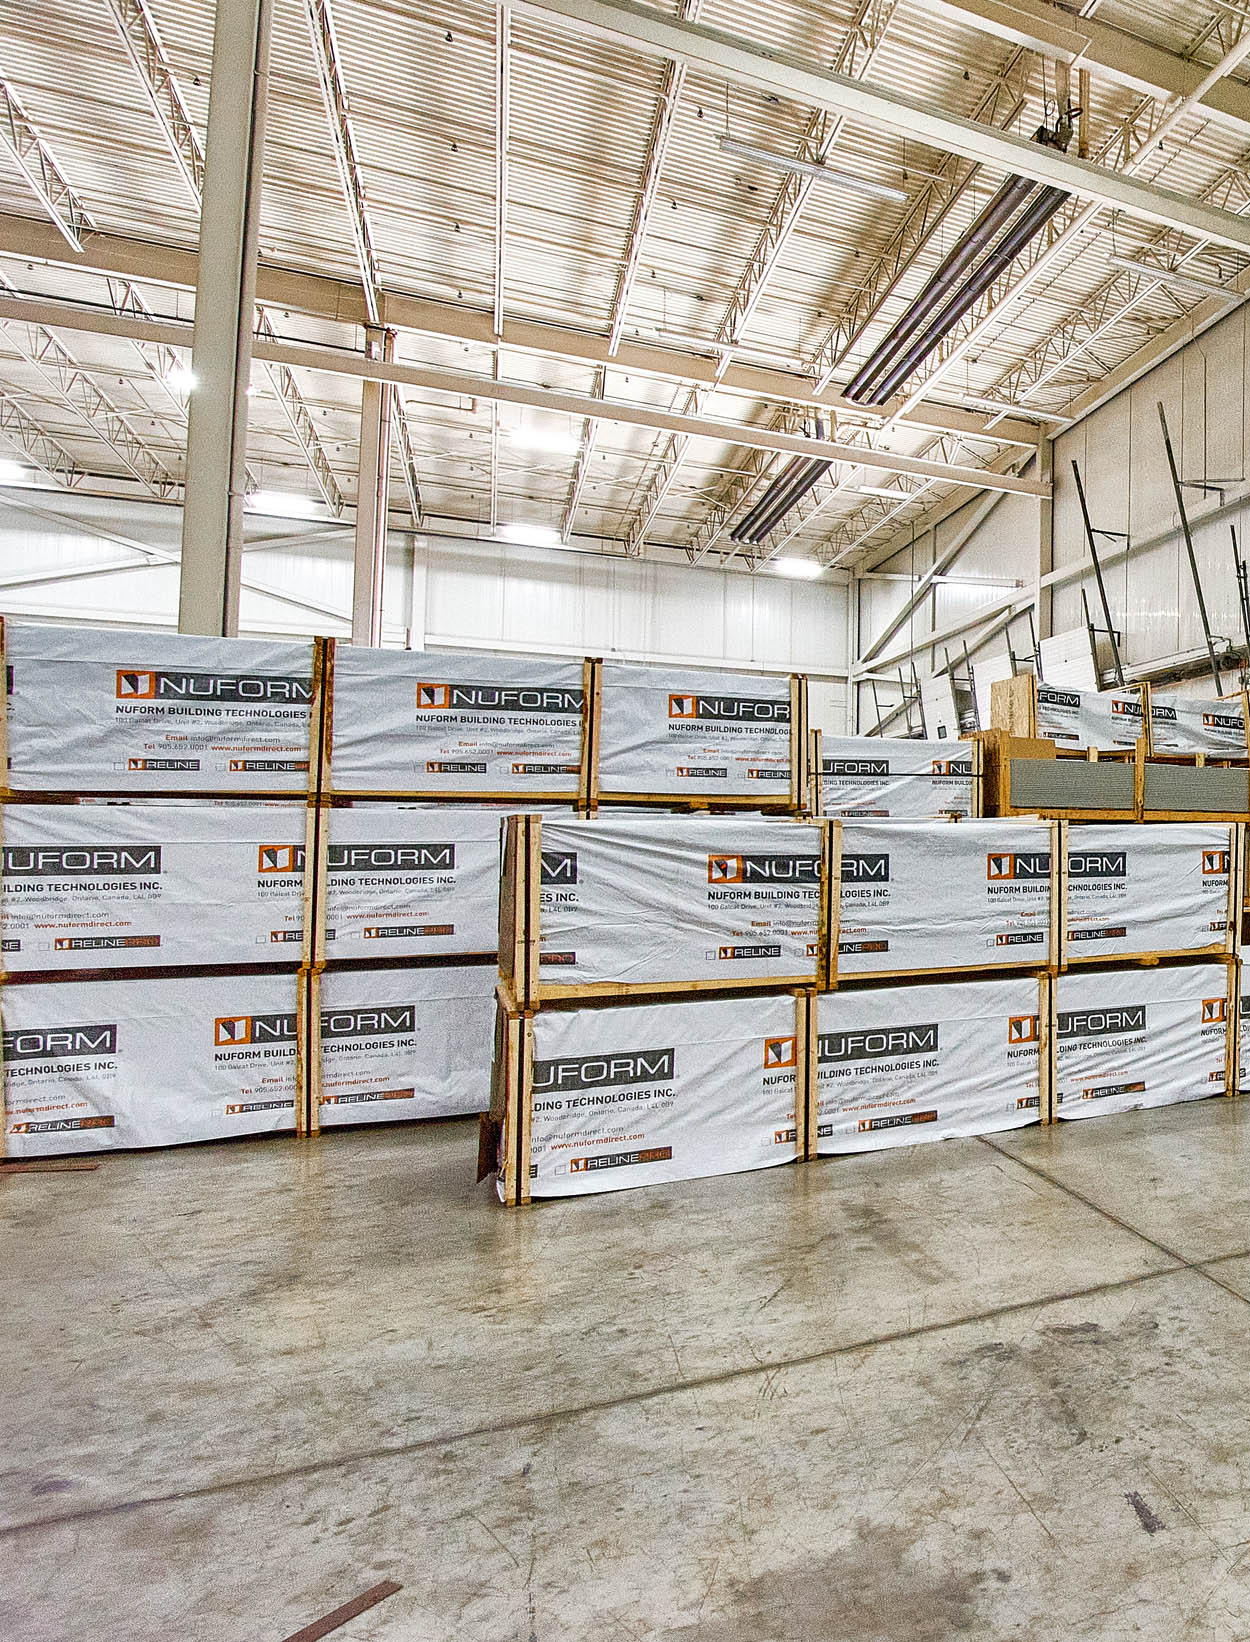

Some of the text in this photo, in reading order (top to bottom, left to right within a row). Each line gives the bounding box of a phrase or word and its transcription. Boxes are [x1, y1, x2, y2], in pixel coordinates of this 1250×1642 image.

[1039, 692, 1080, 705] FORM
[116, 706, 306, 718] NUFORM BUILDING TECHNOLOGIES
[700, 701, 790, 718] NUFOR
[461, 716, 505, 724] BUILDING
[509, 718, 576, 726] TECHNOLOGIES
[823, 763, 887, 773] UFORM
[2, 852, 155, 869] UFORM
[297, 848, 450, 868] UFORM
[1016, 858, 1123, 873] NUORM
[47, 882, 162, 891] TECHNOLOGIES INC.
[258, 880, 302, 888] NUFORM
[359, 877, 434, 886] TECHNOLOGIES
[556, 893, 579, 901] INC.
[708, 889, 890, 900] NUFORM BUILDING INC.
[35, 921, 132, 929] www.nuformdirect.com
[1008, 934, 1043, 943] RELINE
[735, 948, 779, 957] RELINE
[256, 1012, 410, 1037] NUORM
[1036, 1011, 1143, 1034] UFORM
[215, 1039, 417, 1061] NUFORM INC.
[818, 1030, 934, 1057] UFORM
[1079, 1040, 1133, 1050] TECHNOLOGIES
[95, 1062, 118, 1070] INC.
[533, 1056, 669, 1086] UFORM
[763, 1059, 939, 1085] NUFOR TECHNOLOGIES INC.
[566, 1088, 676, 1108] TECHNOLOGIES INC.
[843, 1098, 916, 1112] www.nuformdirect.com
[551, 1132, 645, 1151] www.nuformdirect.com
